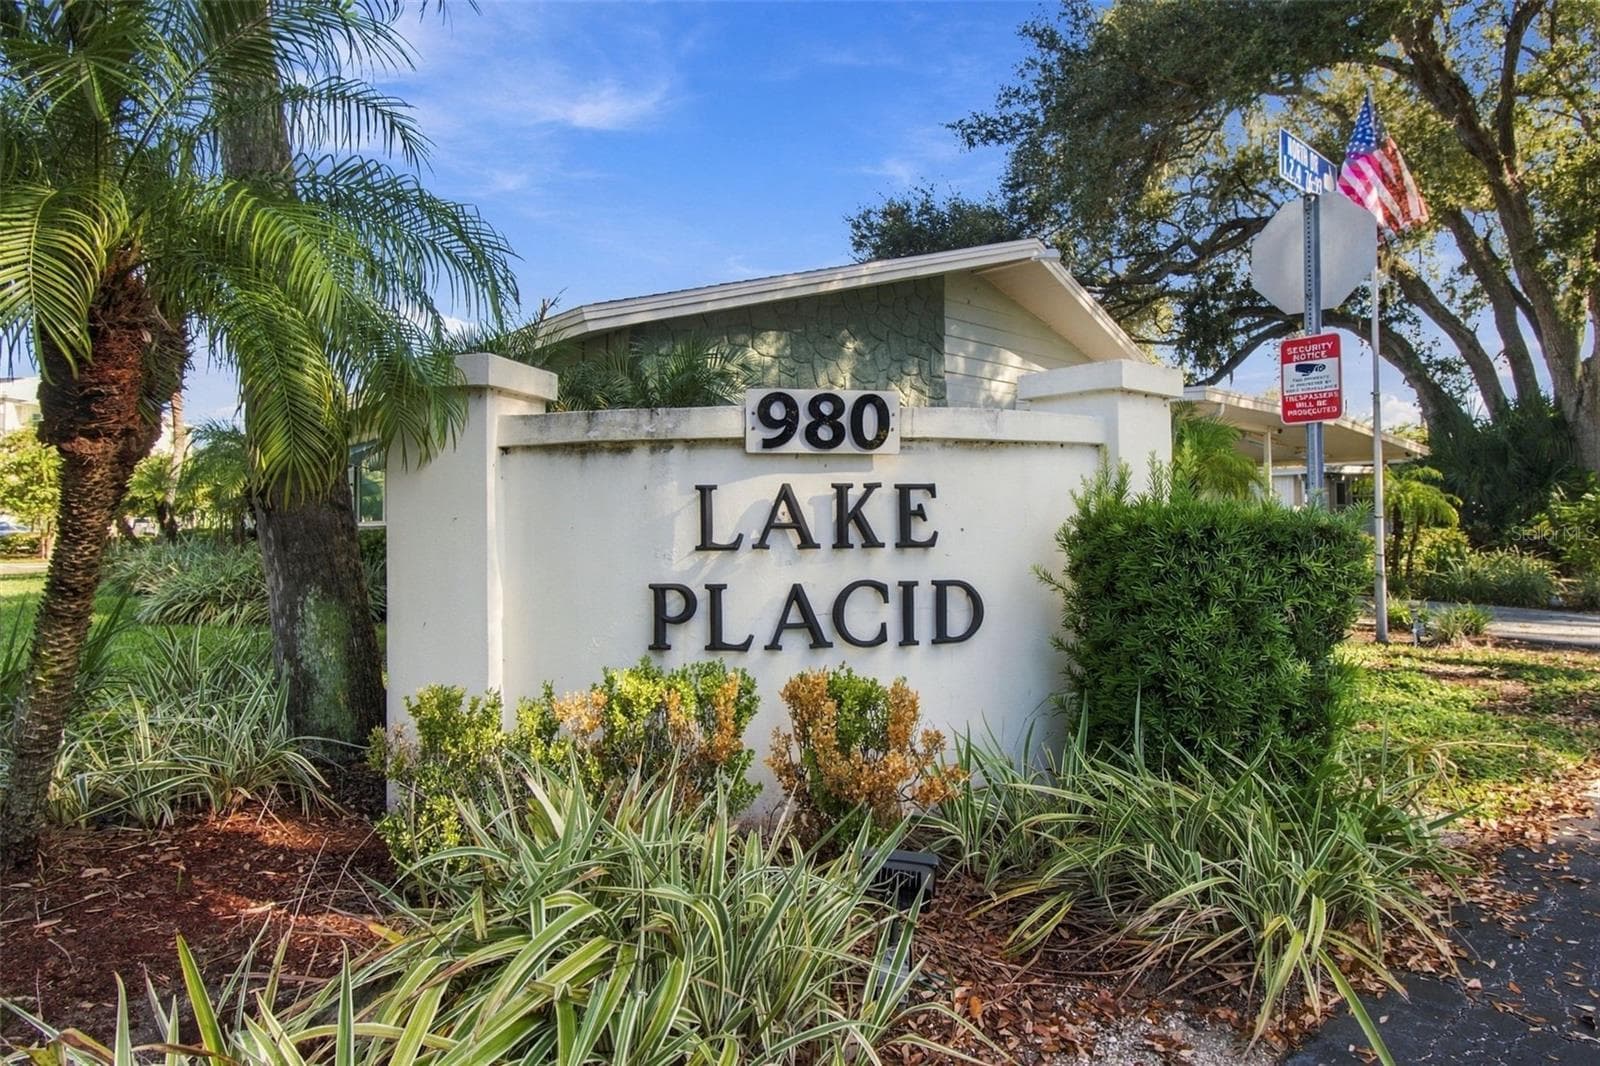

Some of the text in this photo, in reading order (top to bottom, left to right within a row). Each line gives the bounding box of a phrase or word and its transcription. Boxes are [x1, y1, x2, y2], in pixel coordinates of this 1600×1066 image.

[1286, 341, 1334, 355] SECURITY
[1292, 350, 1328, 362] NOTICE
[1285, 391, 1339, 402] TRESPASSERS
[1287, 405, 1338, 416] PROSECUTED
[757, 391, 890, 450] 980
[694, 482, 939, 551] LAKE
[648, 579, 985, 652] PLACID
